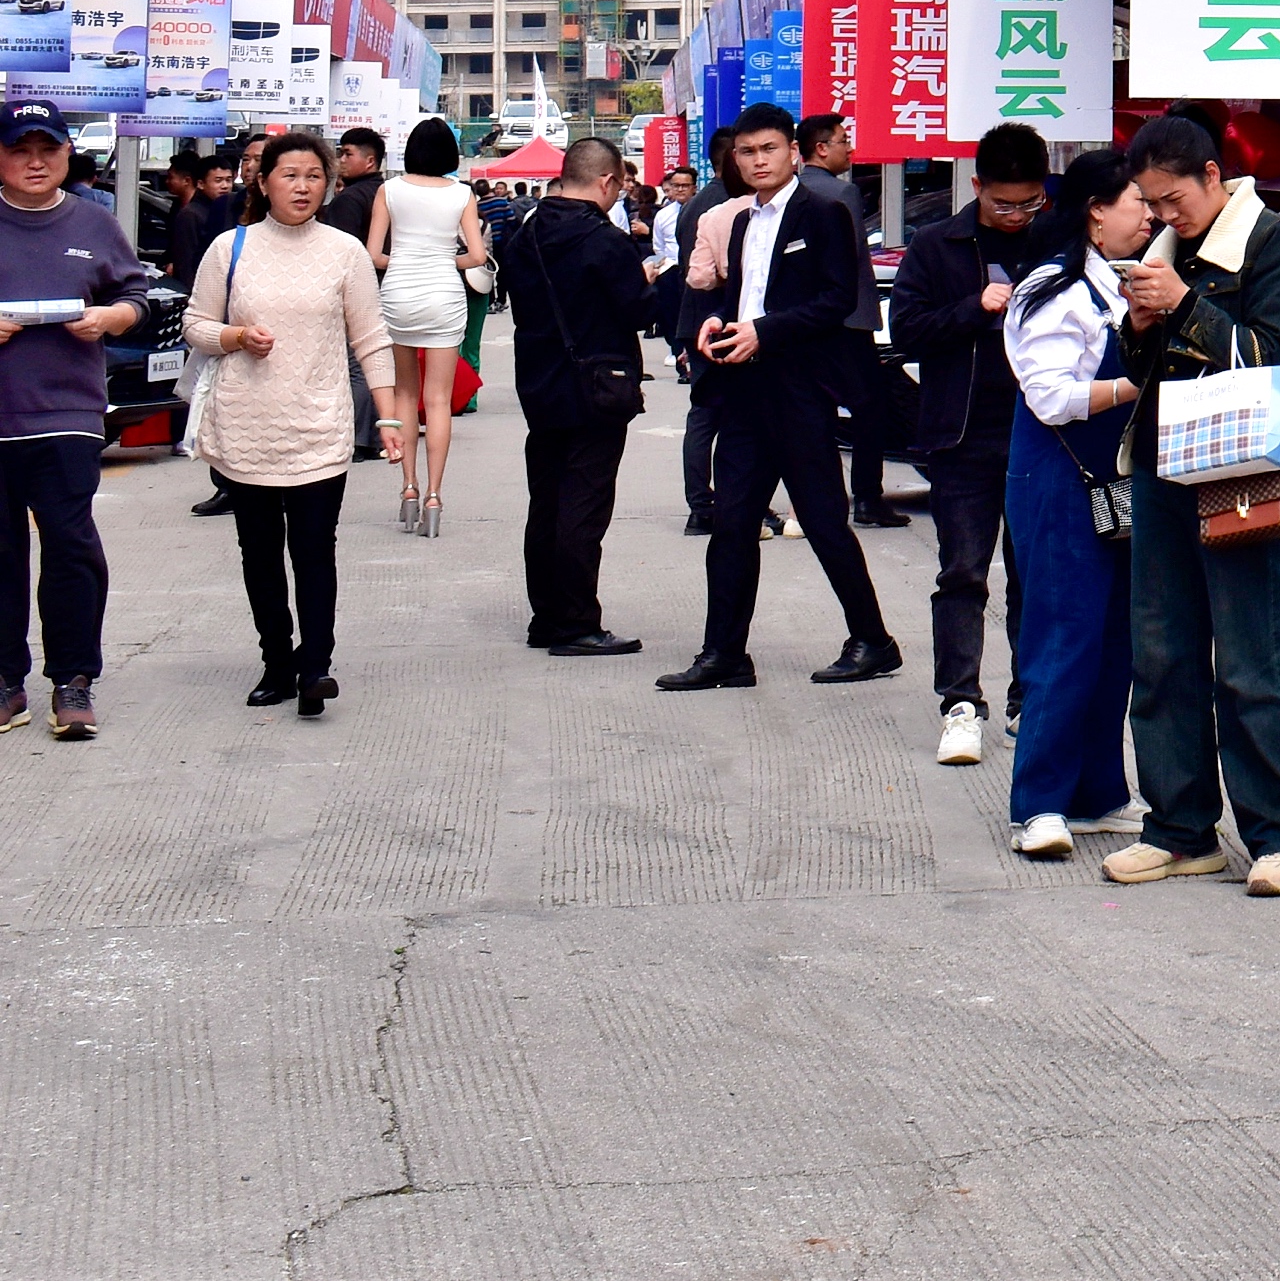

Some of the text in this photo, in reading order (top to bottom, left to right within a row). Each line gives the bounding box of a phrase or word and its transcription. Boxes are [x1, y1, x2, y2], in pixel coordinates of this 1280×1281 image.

[148, 55, 210, 70] 东南浩宇
[663, 131, 680, 173] 奇瑞汽
